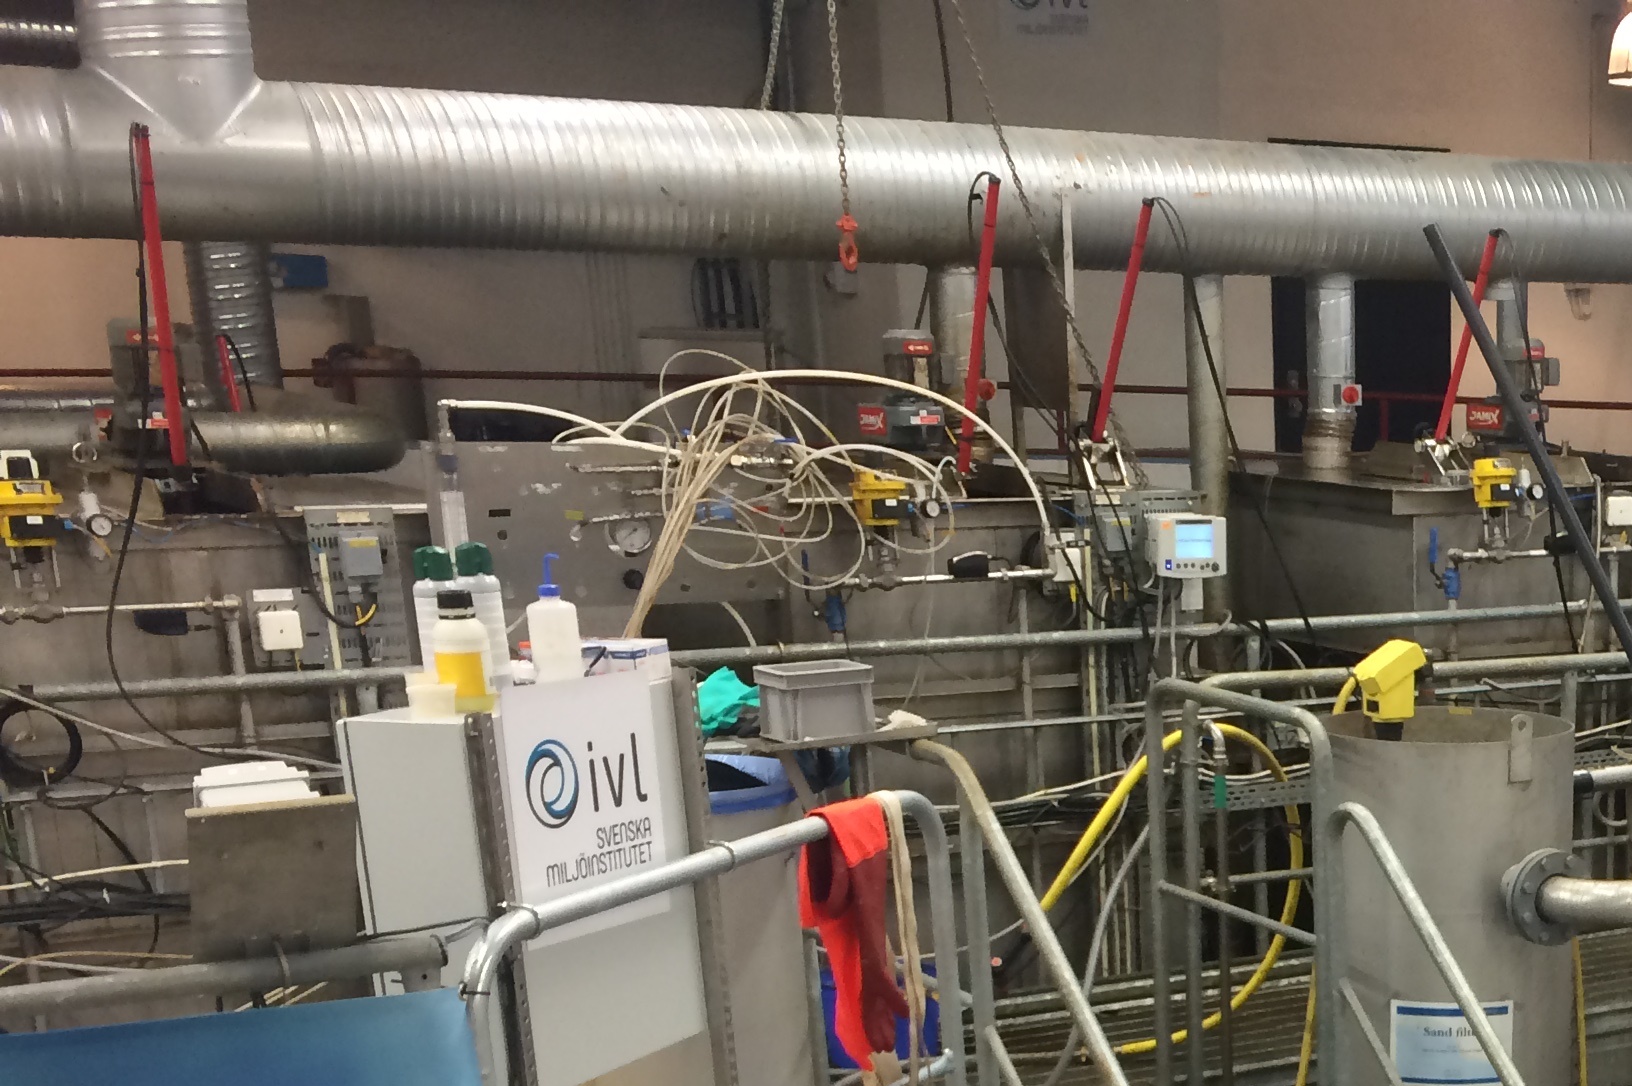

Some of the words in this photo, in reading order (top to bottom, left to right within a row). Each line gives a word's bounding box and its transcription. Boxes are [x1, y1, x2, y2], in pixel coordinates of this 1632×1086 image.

[587, 732, 648, 812] ivl
[596, 817, 652, 849] SVENSKA
[546, 841, 653, 887] MILJÖINSTITUTET
[1423, 1027, 1452, 1037] Sand
